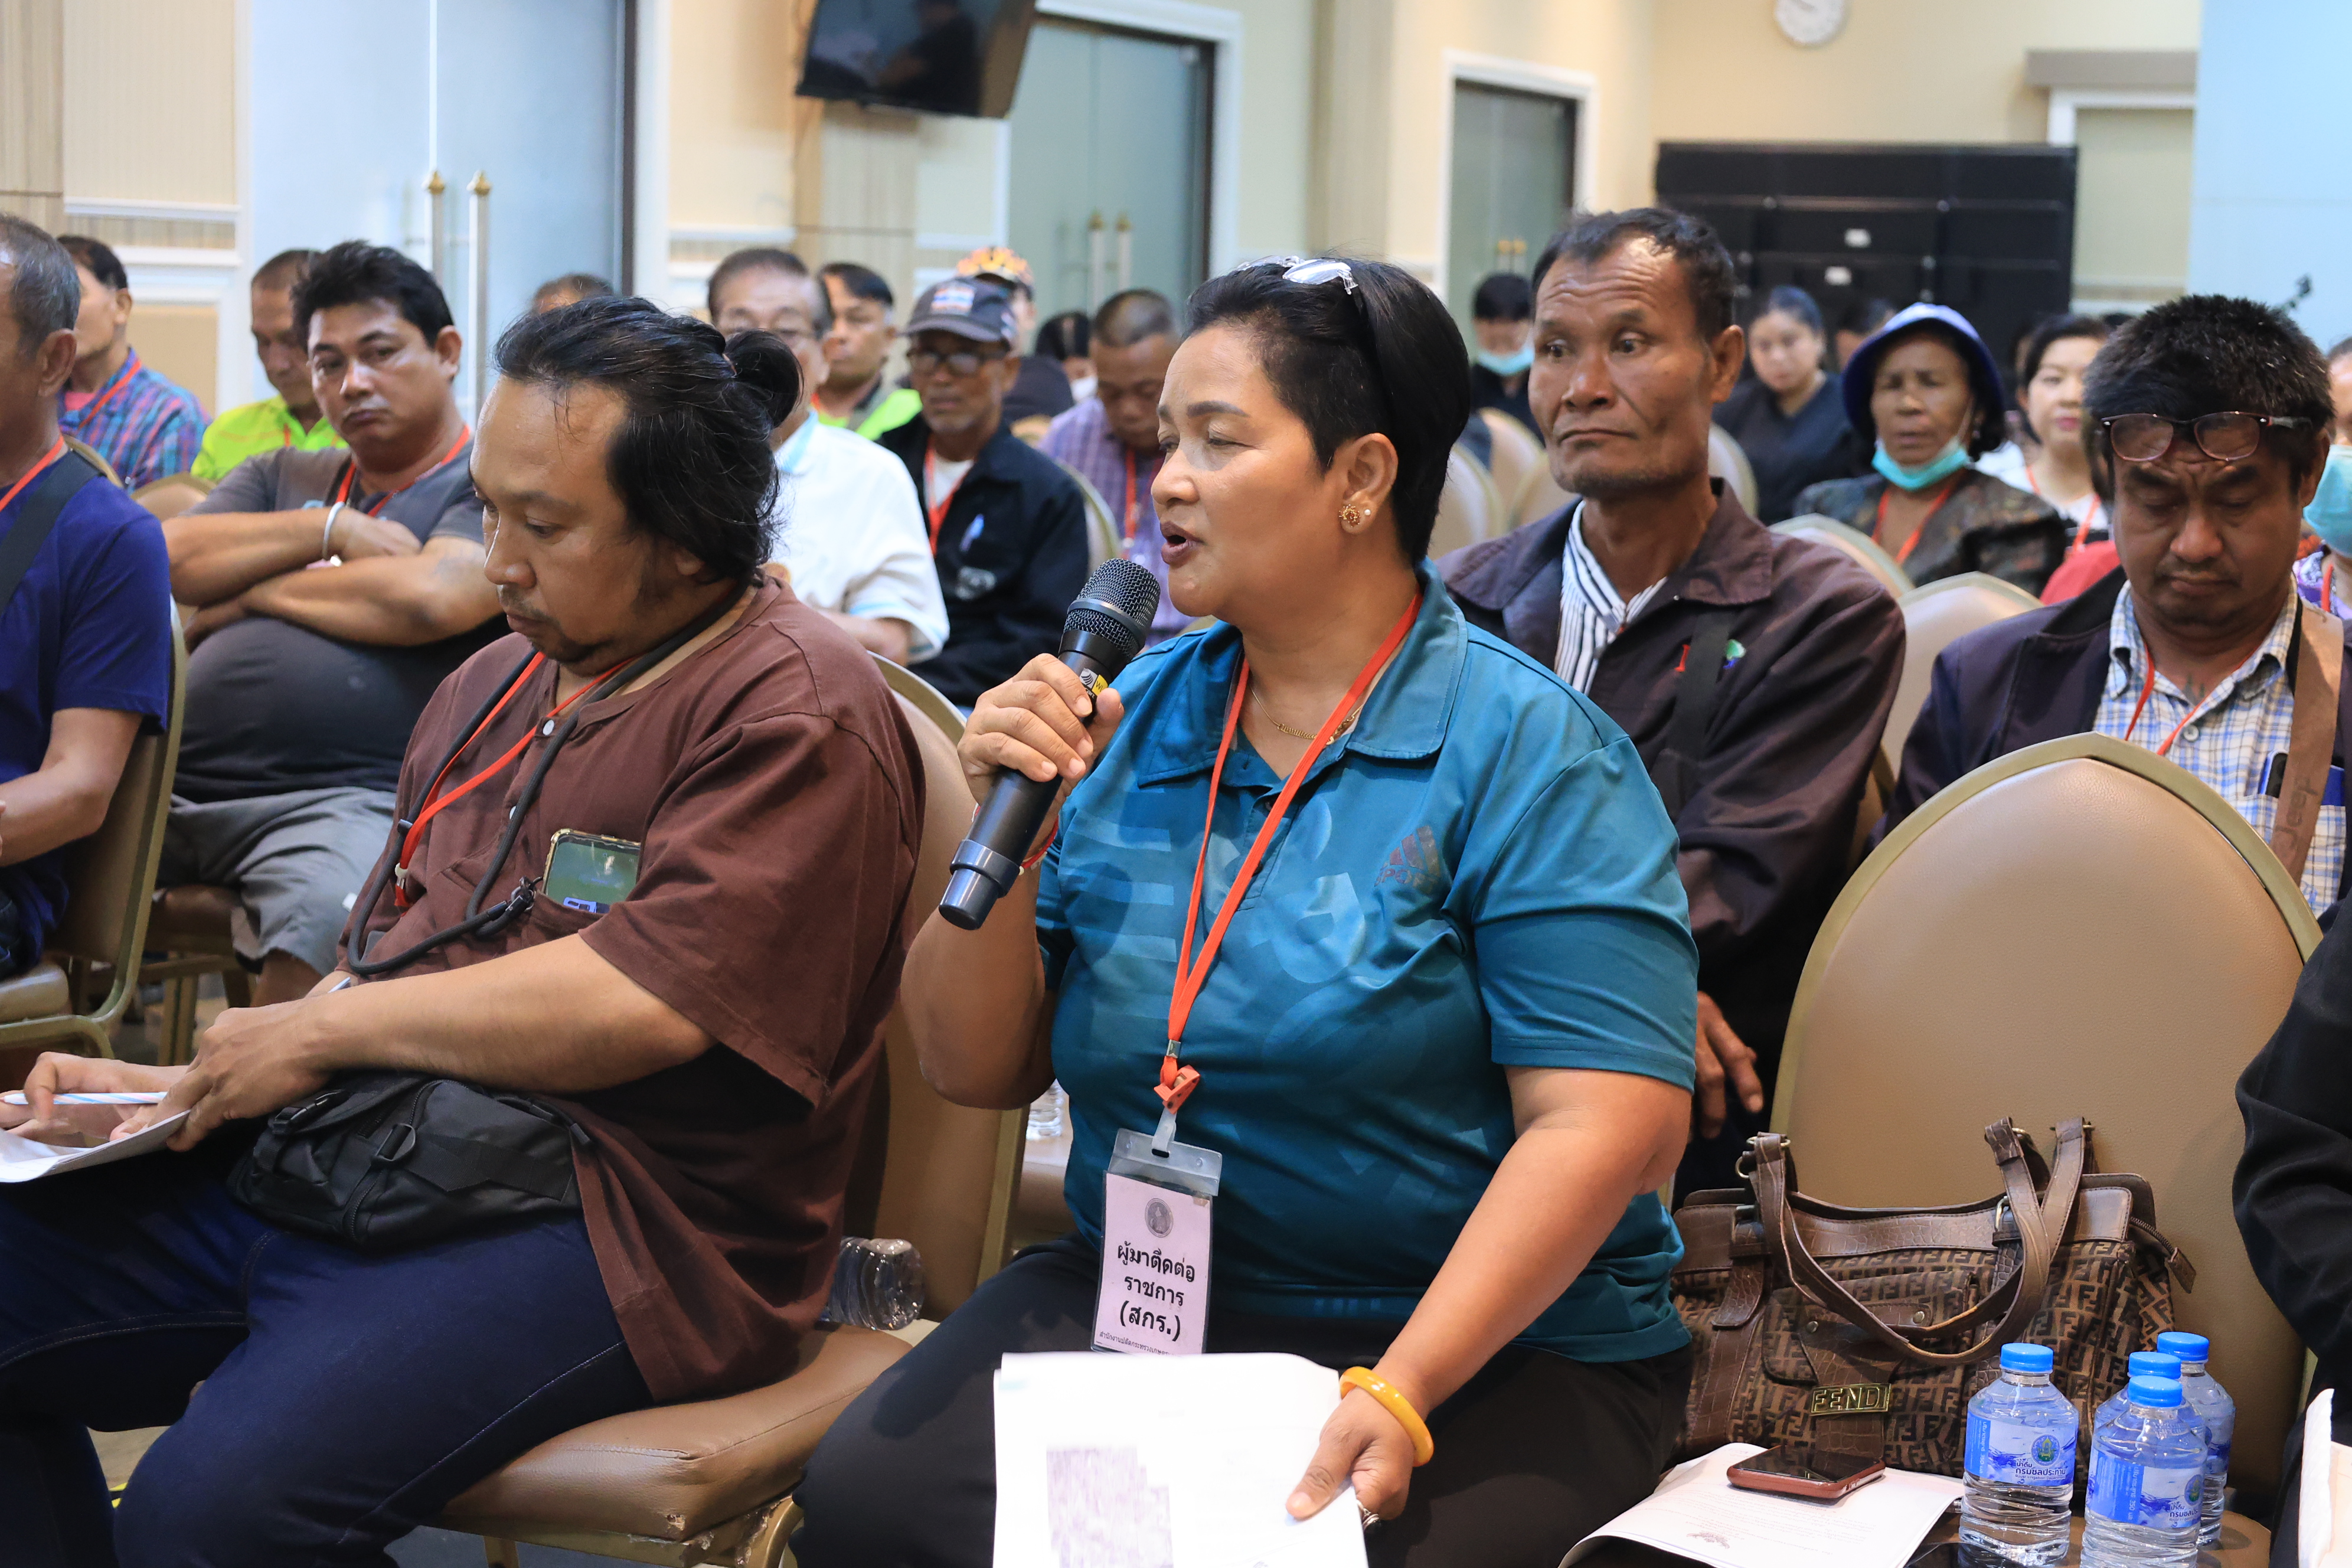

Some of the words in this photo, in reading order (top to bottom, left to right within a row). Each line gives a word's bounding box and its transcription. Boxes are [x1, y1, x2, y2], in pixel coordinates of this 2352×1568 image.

[1124, 1275, 1184, 1306] ราชการ
[1120, 1301, 1181, 1342] (สกร.)
[1814, 1387, 1887, 1412] FENDI
